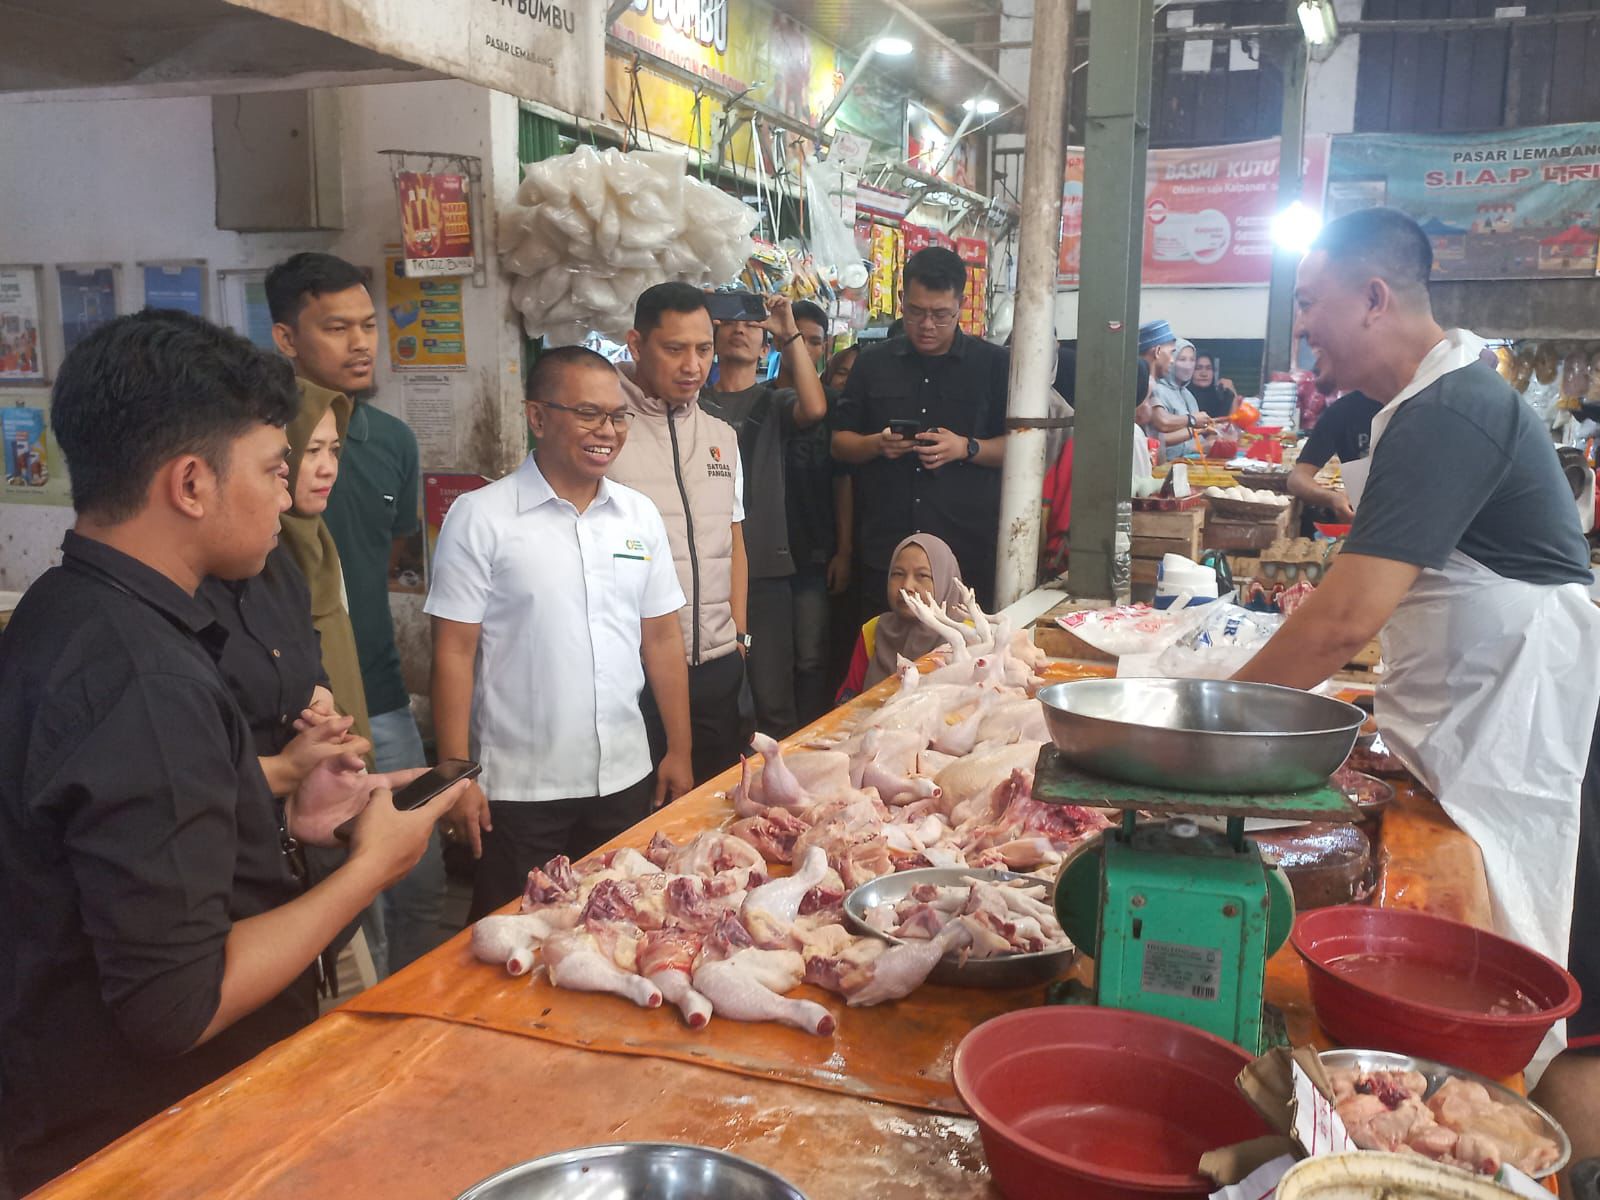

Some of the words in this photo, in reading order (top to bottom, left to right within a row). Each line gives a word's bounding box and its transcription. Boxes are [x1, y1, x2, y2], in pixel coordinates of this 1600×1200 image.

[517, 0, 575, 34] BUMBU
[485, 34, 509, 53] PASAR
[1453, 150, 1507, 163] PASAR
[1164, 161, 1218, 180] BASMI
[1226, 159, 1276, 179] KUTU
[1425, 167, 1531, 186] S.I.A.P
